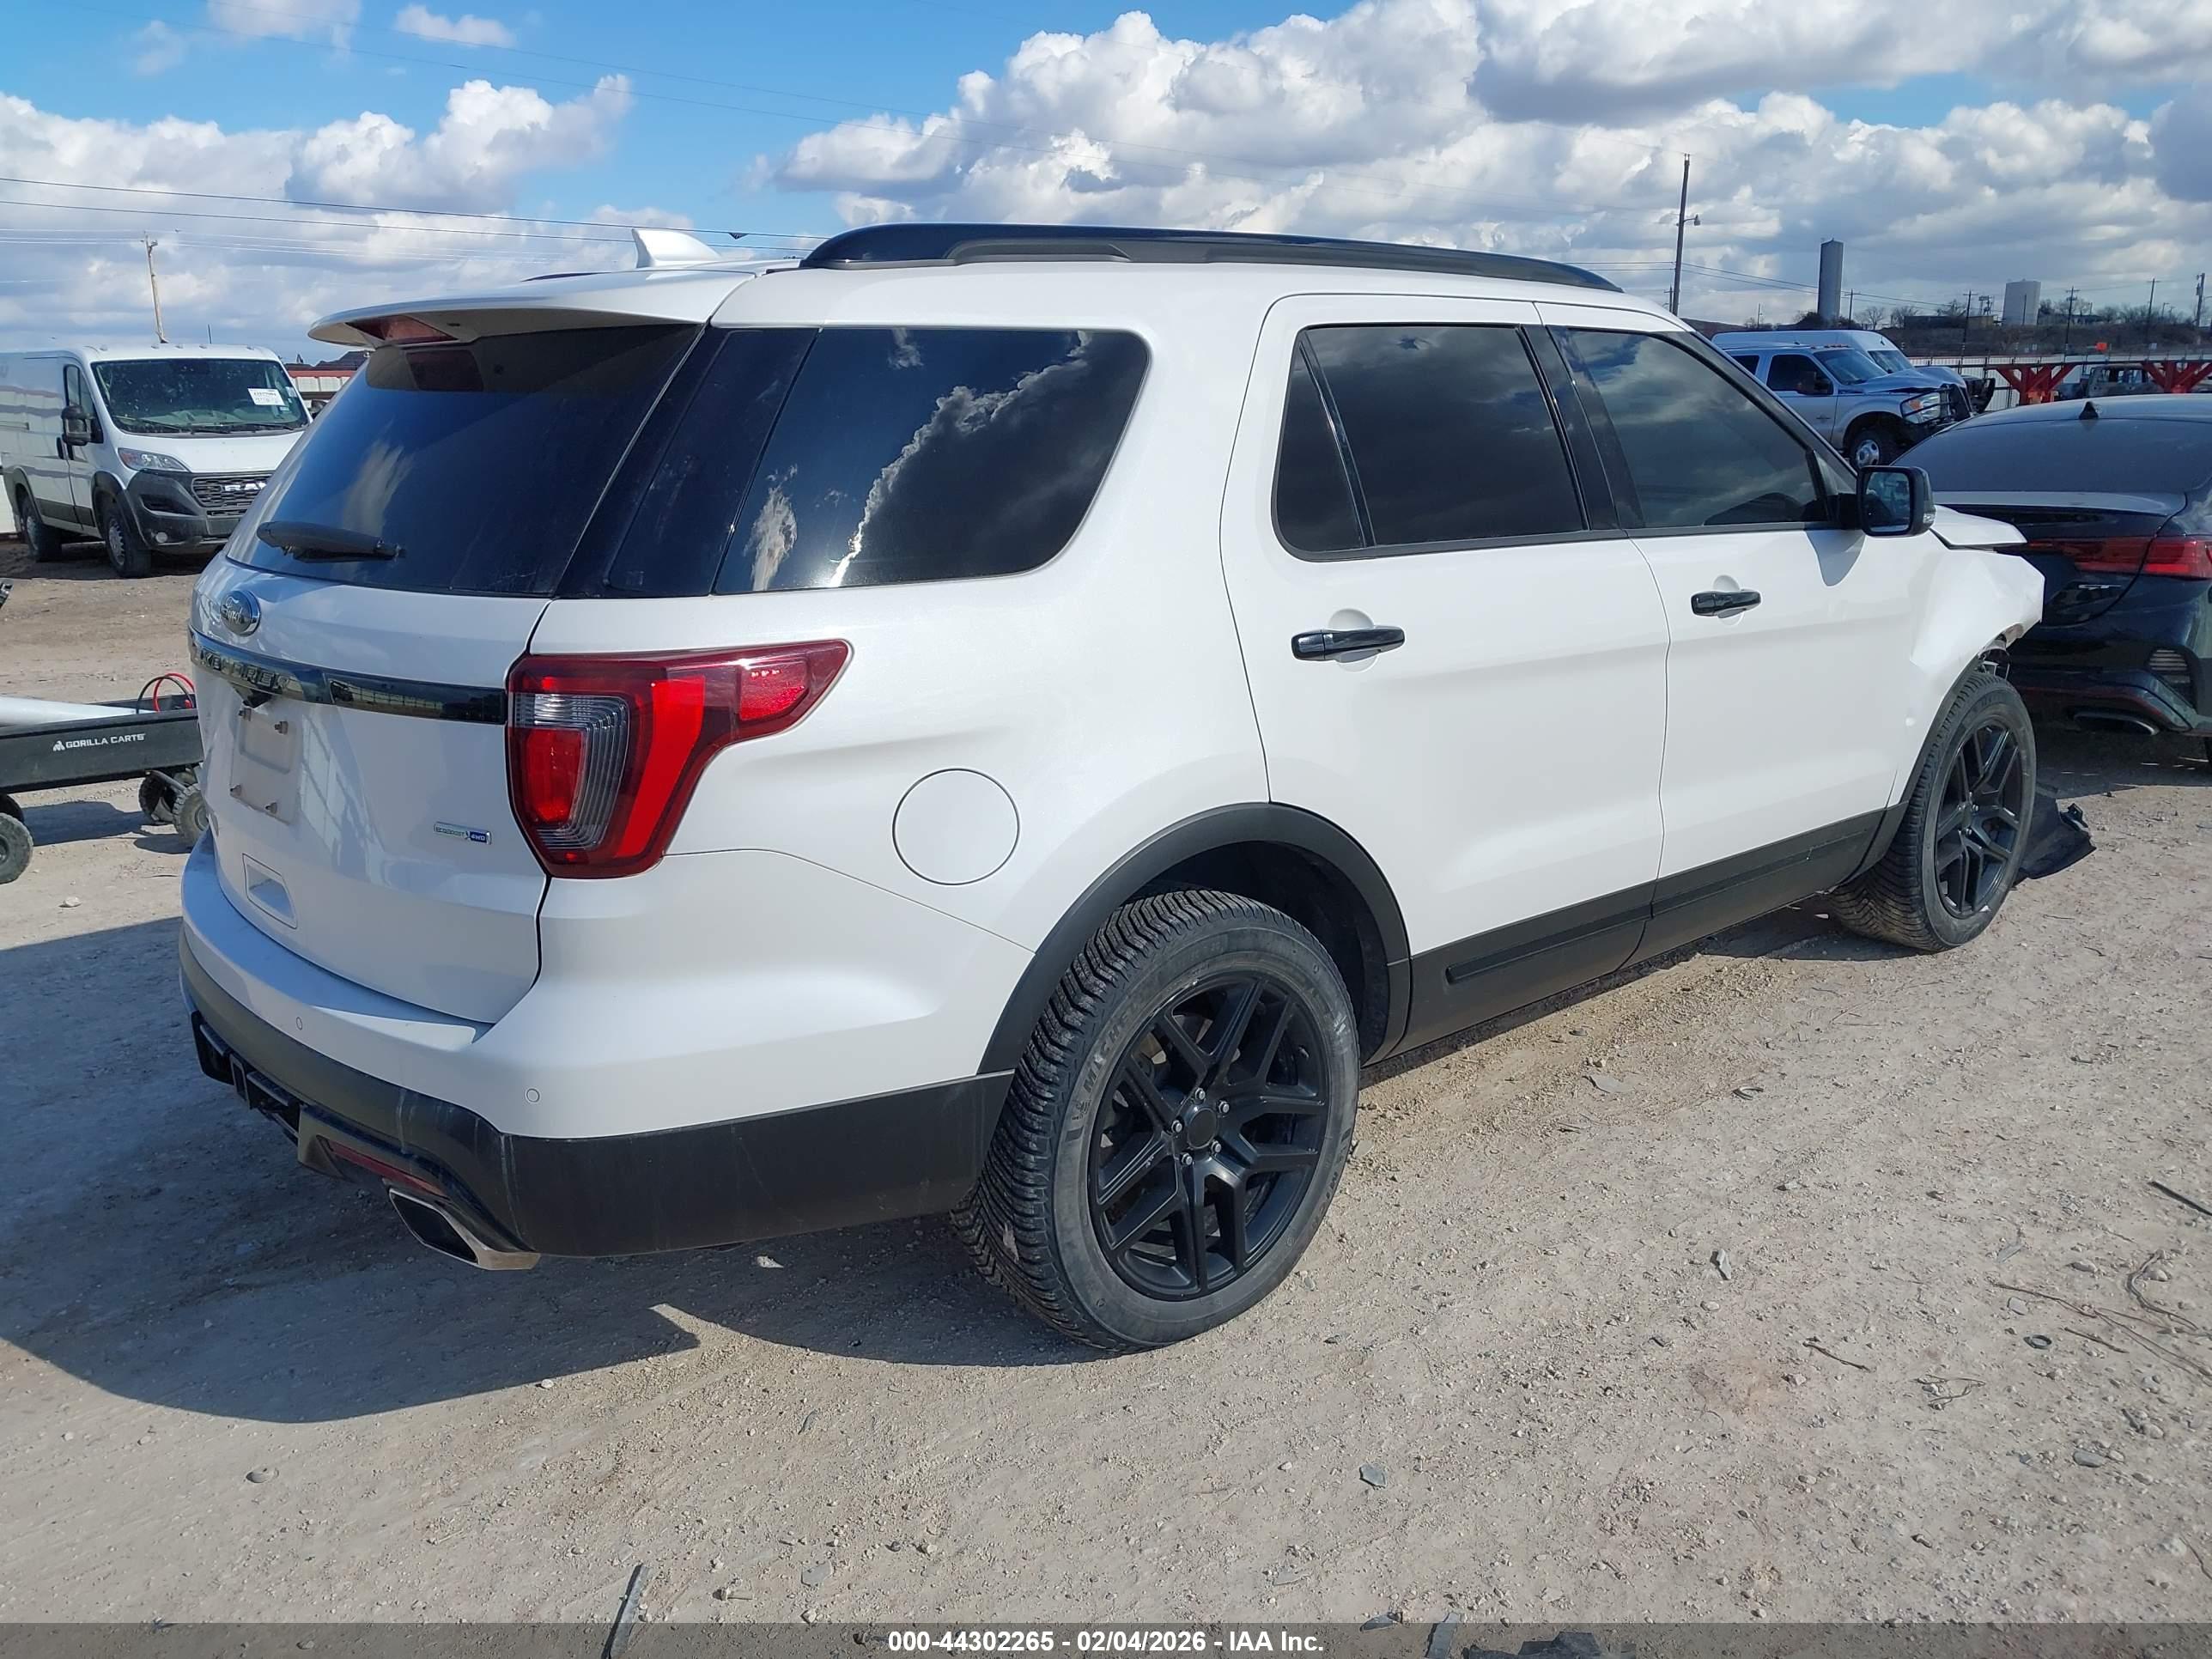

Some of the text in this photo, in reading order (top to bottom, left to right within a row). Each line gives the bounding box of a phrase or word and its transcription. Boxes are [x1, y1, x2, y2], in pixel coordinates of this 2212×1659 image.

[223, 596, 244, 621] Ford
[66, 738, 108, 749] GORILLA
[471, 833, 486, 842] 4WD
